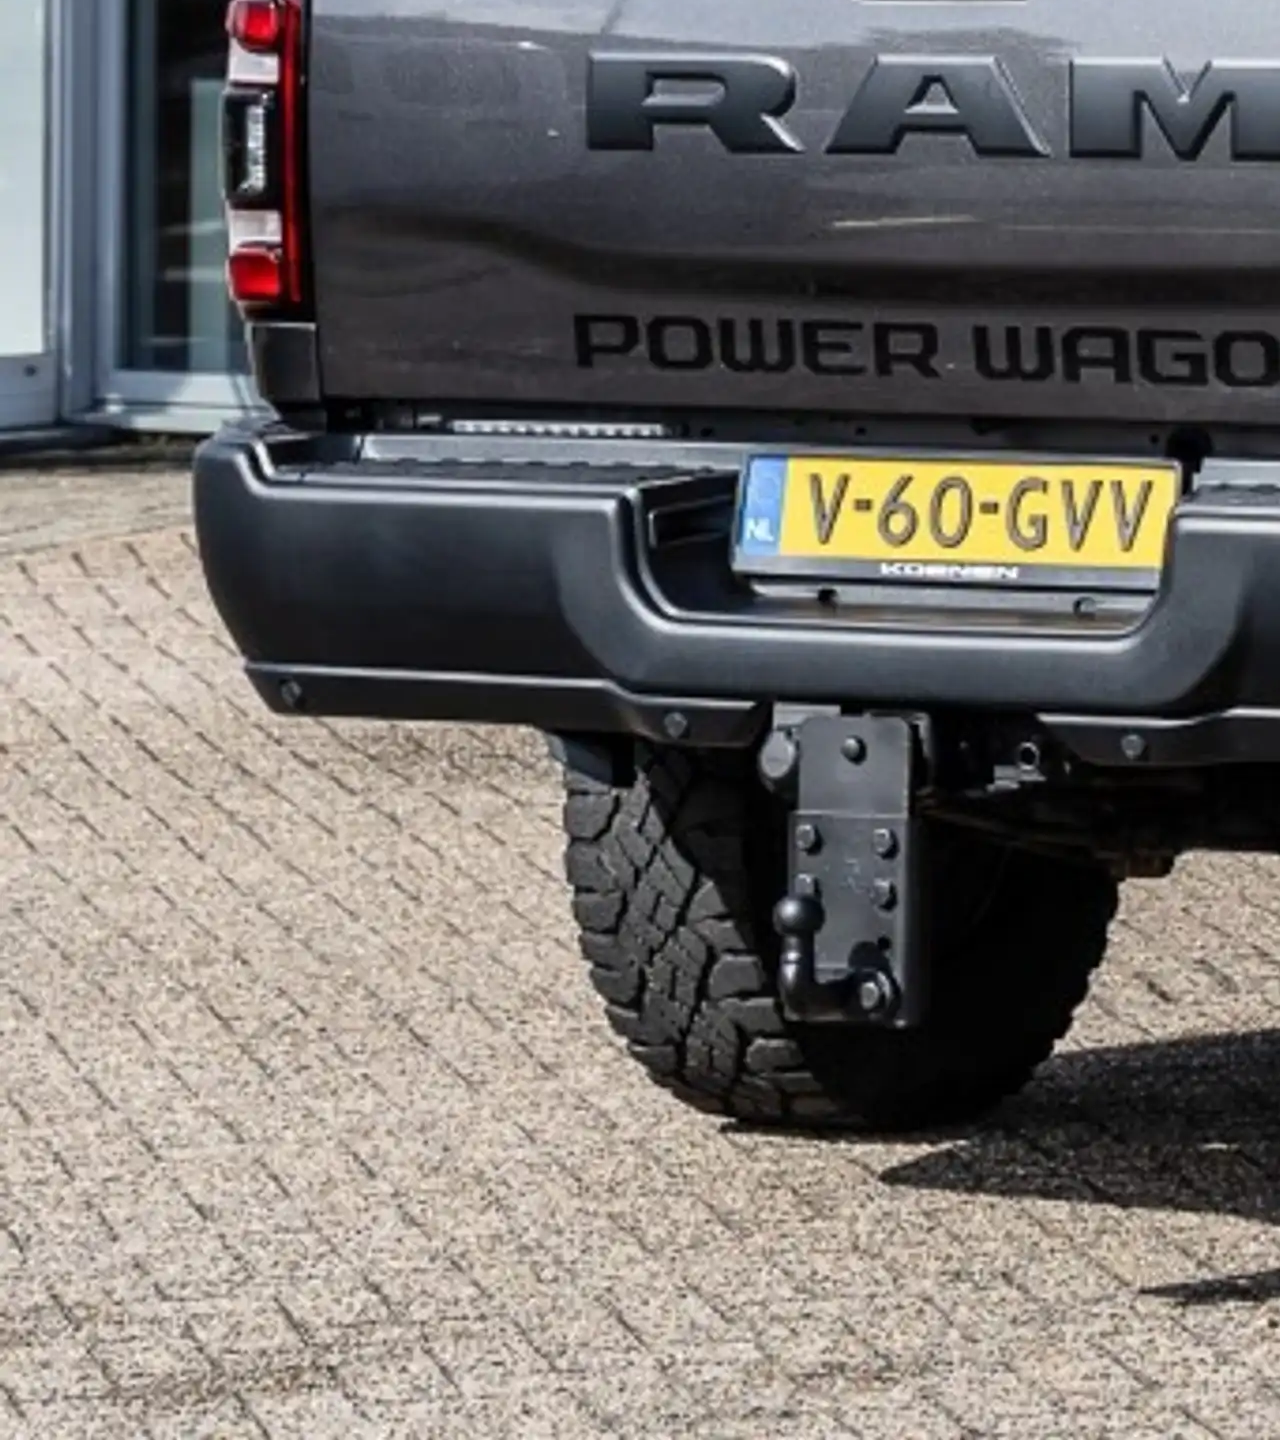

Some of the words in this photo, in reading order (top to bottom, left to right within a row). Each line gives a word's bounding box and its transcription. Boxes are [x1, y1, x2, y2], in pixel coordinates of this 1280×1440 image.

[573, 313, 945, 379] POWER
[747, 519, 775, 543] NL
[809, 471, 1154, 552] V-60-GVV
[879, 561, 1020, 580] KOENEN
